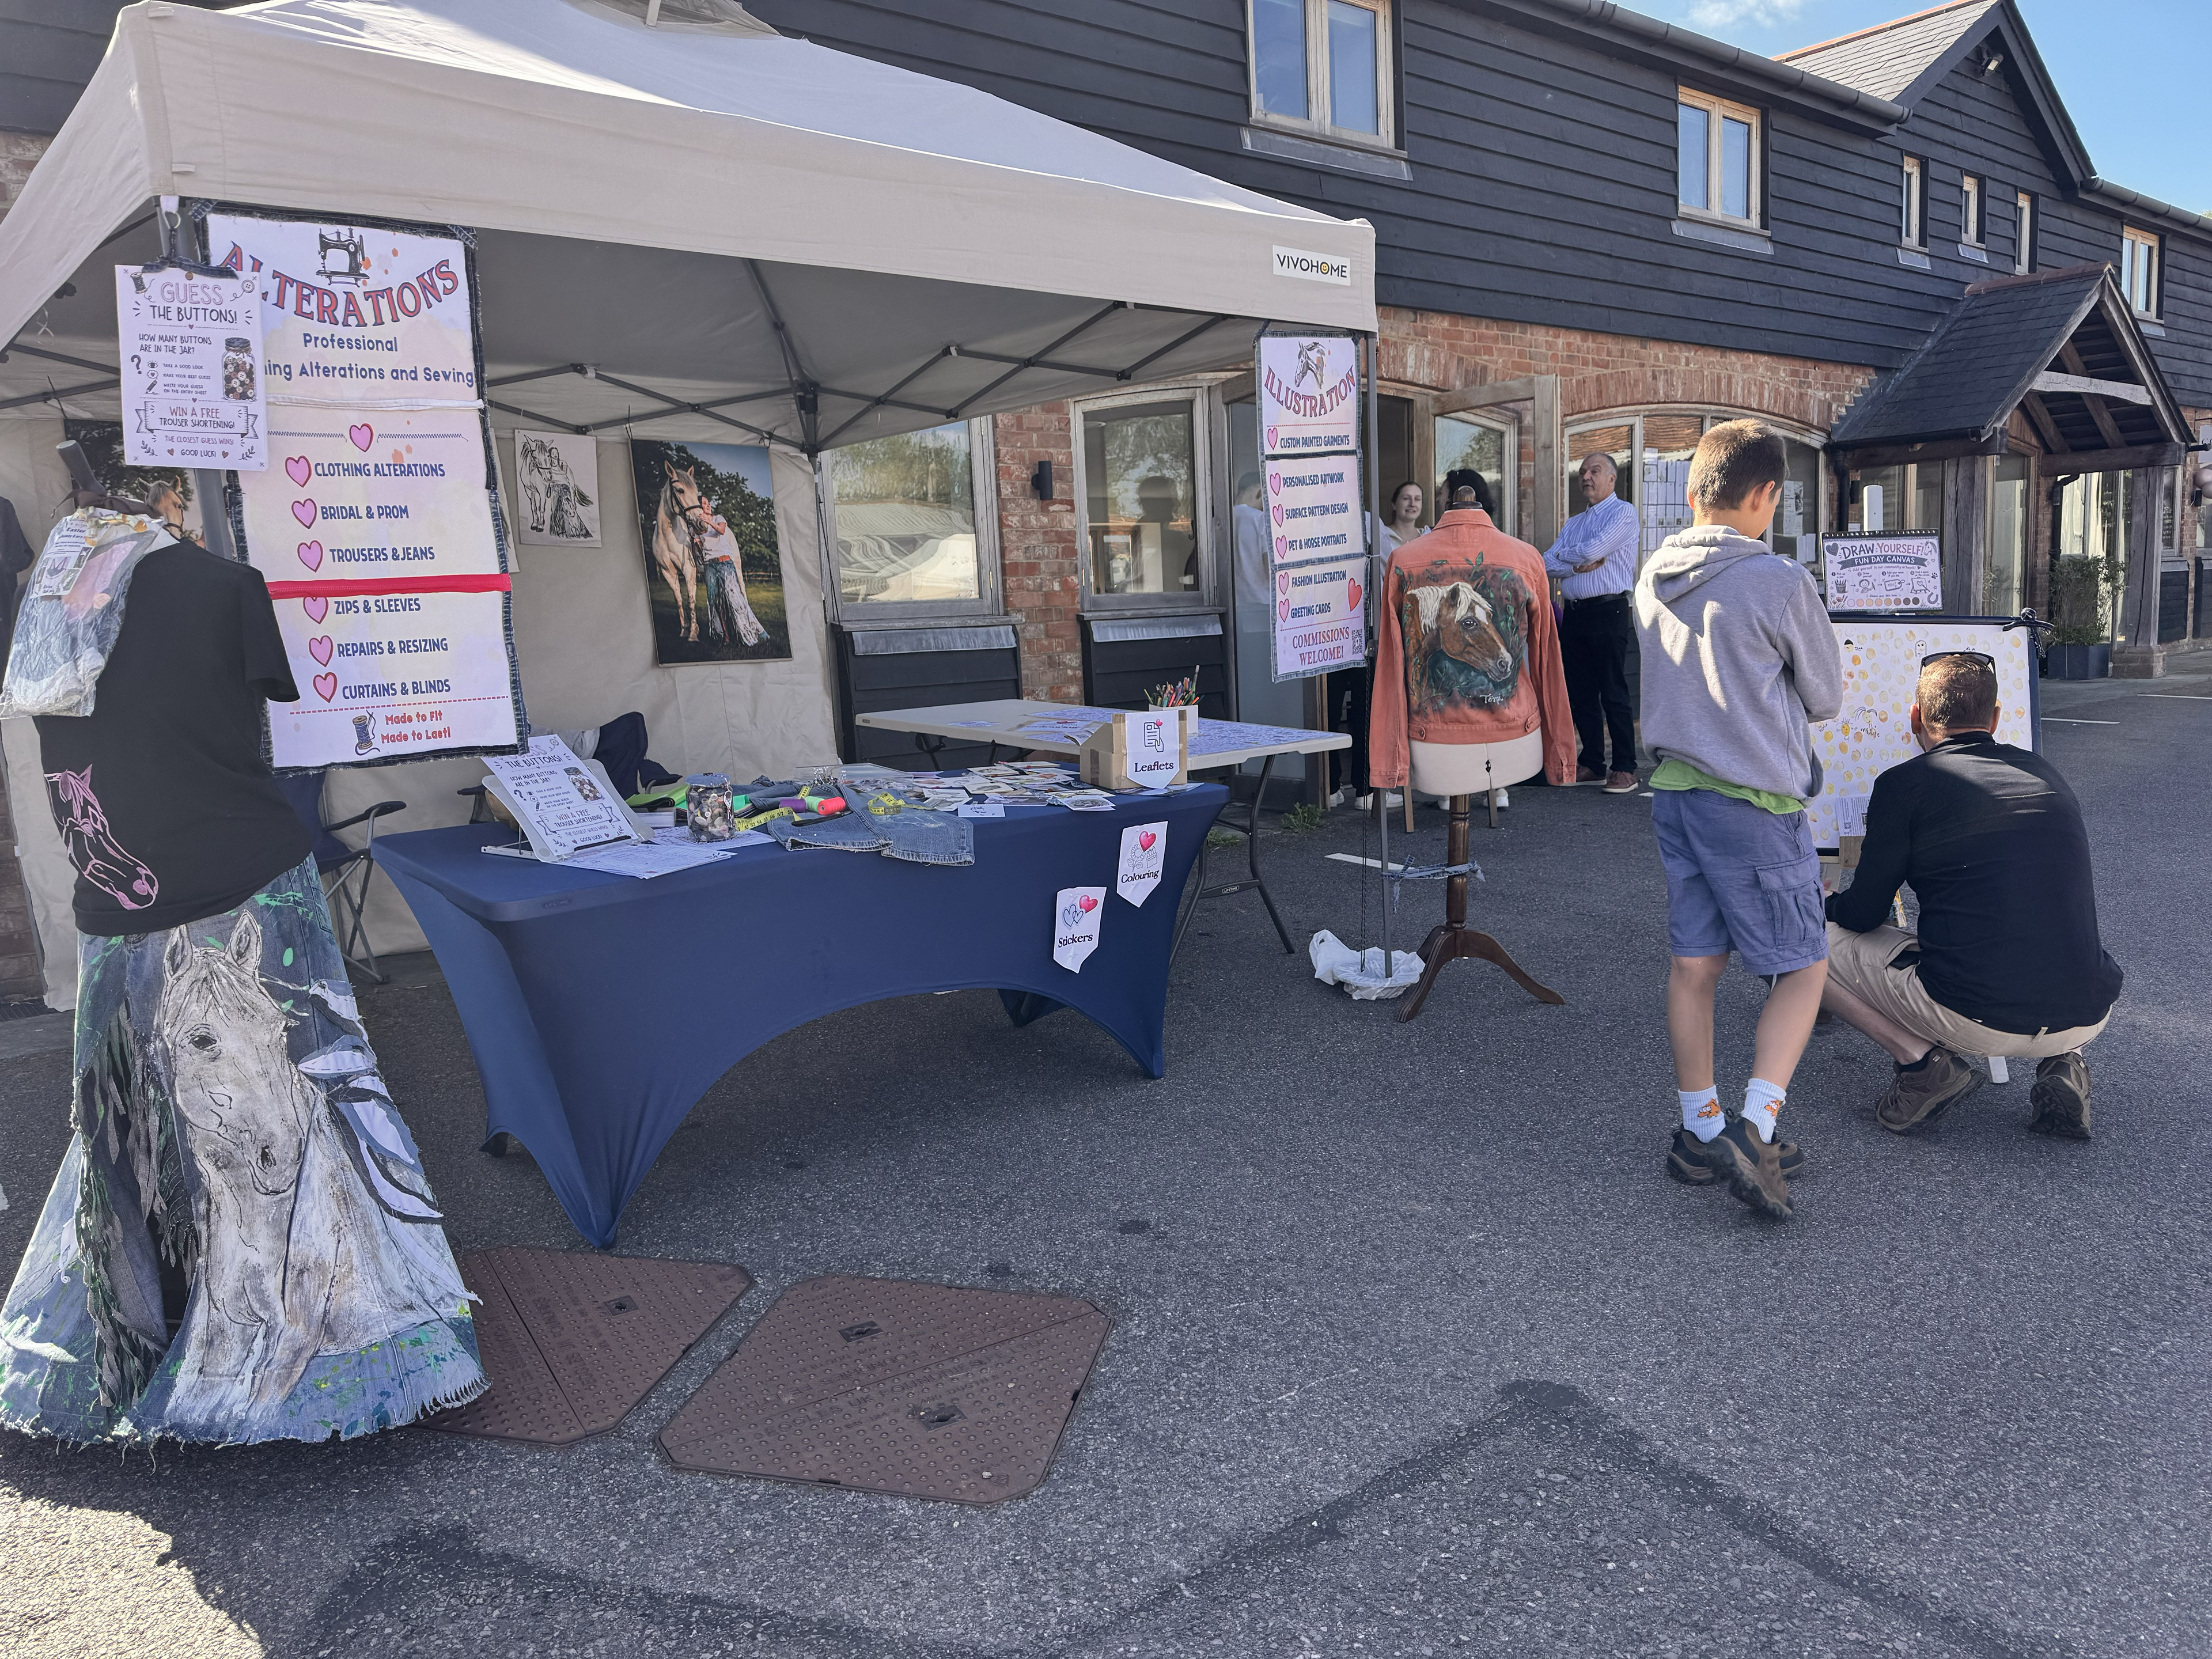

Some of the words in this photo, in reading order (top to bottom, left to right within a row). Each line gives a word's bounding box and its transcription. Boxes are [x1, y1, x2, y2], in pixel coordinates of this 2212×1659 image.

[1277, 253, 1347, 278] VIVOHOME
[160, 282, 224, 305] GUESS
[149, 305, 174, 322] THE
[177, 308, 237, 324] BUTTONS!
[139, 334, 155, 343] HOW
[158, 335, 179, 344] MANY
[180, 335, 212, 345] BUTTONS
[303, 332, 399, 353] Professional
[139, 344, 152, 353] ARE
[154, 344, 162, 353] IN
[164, 345, 177, 354] THE
[179, 346, 195, 355] JAR?
[299, 364, 385, 380] Alterations
[391, 368, 419, 381] and
[1264, 365, 1355, 418] ILLUSTRATION
[169, 406, 188, 417] WIN
[191, 407, 198, 418] A
[201, 408, 220, 419] FREE
[159, 416, 188, 427] TROUSER
[190, 418, 235, 429] SHORTENING!
[176, 435, 199, 444] CLOSEST
[200, 437, 217, 445] GUESS
[1280, 437, 1300, 449] CUSTOM
[1301, 435, 1323, 448] PAINTED
[1323, 434, 1350, 446] GARMENTS
[315, 463, 372, 478] CLOTHING
[374, 463, 446, 477] ALTERATIONS
[1282, 474, 1319, 488] PERSONALISED
[1320, 472, 1344, 484] ARTWORK
[320, 505, 363, 520] BRIDAL
[365, 507, 376, 520] &
[377, 505, 410, 520] PROM
[1285, 506, 1308, 520] SURFACE
[1308, 505, 1330, 517] PATTERN
[1330, 502, 1349, 514] DESIGN
[1289, 540, 1298, 551] PET
[1298, 539, 1303, 550] &
[1304, 536, 1320, 549] HORSE
[1321, 533, 1347, 547] PORTRAITS
[329, 547, 389, 563] TROUSERS
[400, 546, 435, 562] JEANS
[1841, 543, 1874, 559] DRAW
[1877, 542, 1924, 555] YOURSELF!
[1854, 557, 1869, 565] FUN
[1291, 574, 1313, 588] FASHION
[1313, 570, 1347, 585] ILLUSTRATION
[334, 600, 360, 615] ZIPS
[362, 599, 372, 614] &
[374, 597, 421, 613] SLEEVES
[1291, 606, 1315, 619] GREETING
[1315, 602, 1331, 615] CARDS
[1292, 627, 1350, 649] COMMISSIONS
[336, 641, 385, 658] REPAIRS
[387, 641, 396, 655] &
[399, 638, 448, 654] RESIZING
[1299, 645, 1344, 666] WELCOME!
[342, 682, 397, 700] CURTAINS
[400, 681, 410, 696] &
[412, 679, 451, 695] BLINDS
[385, 714, 413, 726] Made
[415, 712, 427, 723] to
[429, 710, 443, 722] Fit
[381, 732, 409, 744] Made
[411, 730, 423, 741] to
[505, 760, 524, 768] THE
[522, 755, 563, 767] BUTTONS!
[1134, 761, 1174, 772] Leaflets
[556, 813, 570, 821] WIN
[575, 809, 590, 818] FREE
[574, 814, 603, 824] SHORTENING!
[1121, 869, 1160, 884] Colouring
[1058, 934, 1093, 948] Stickers
